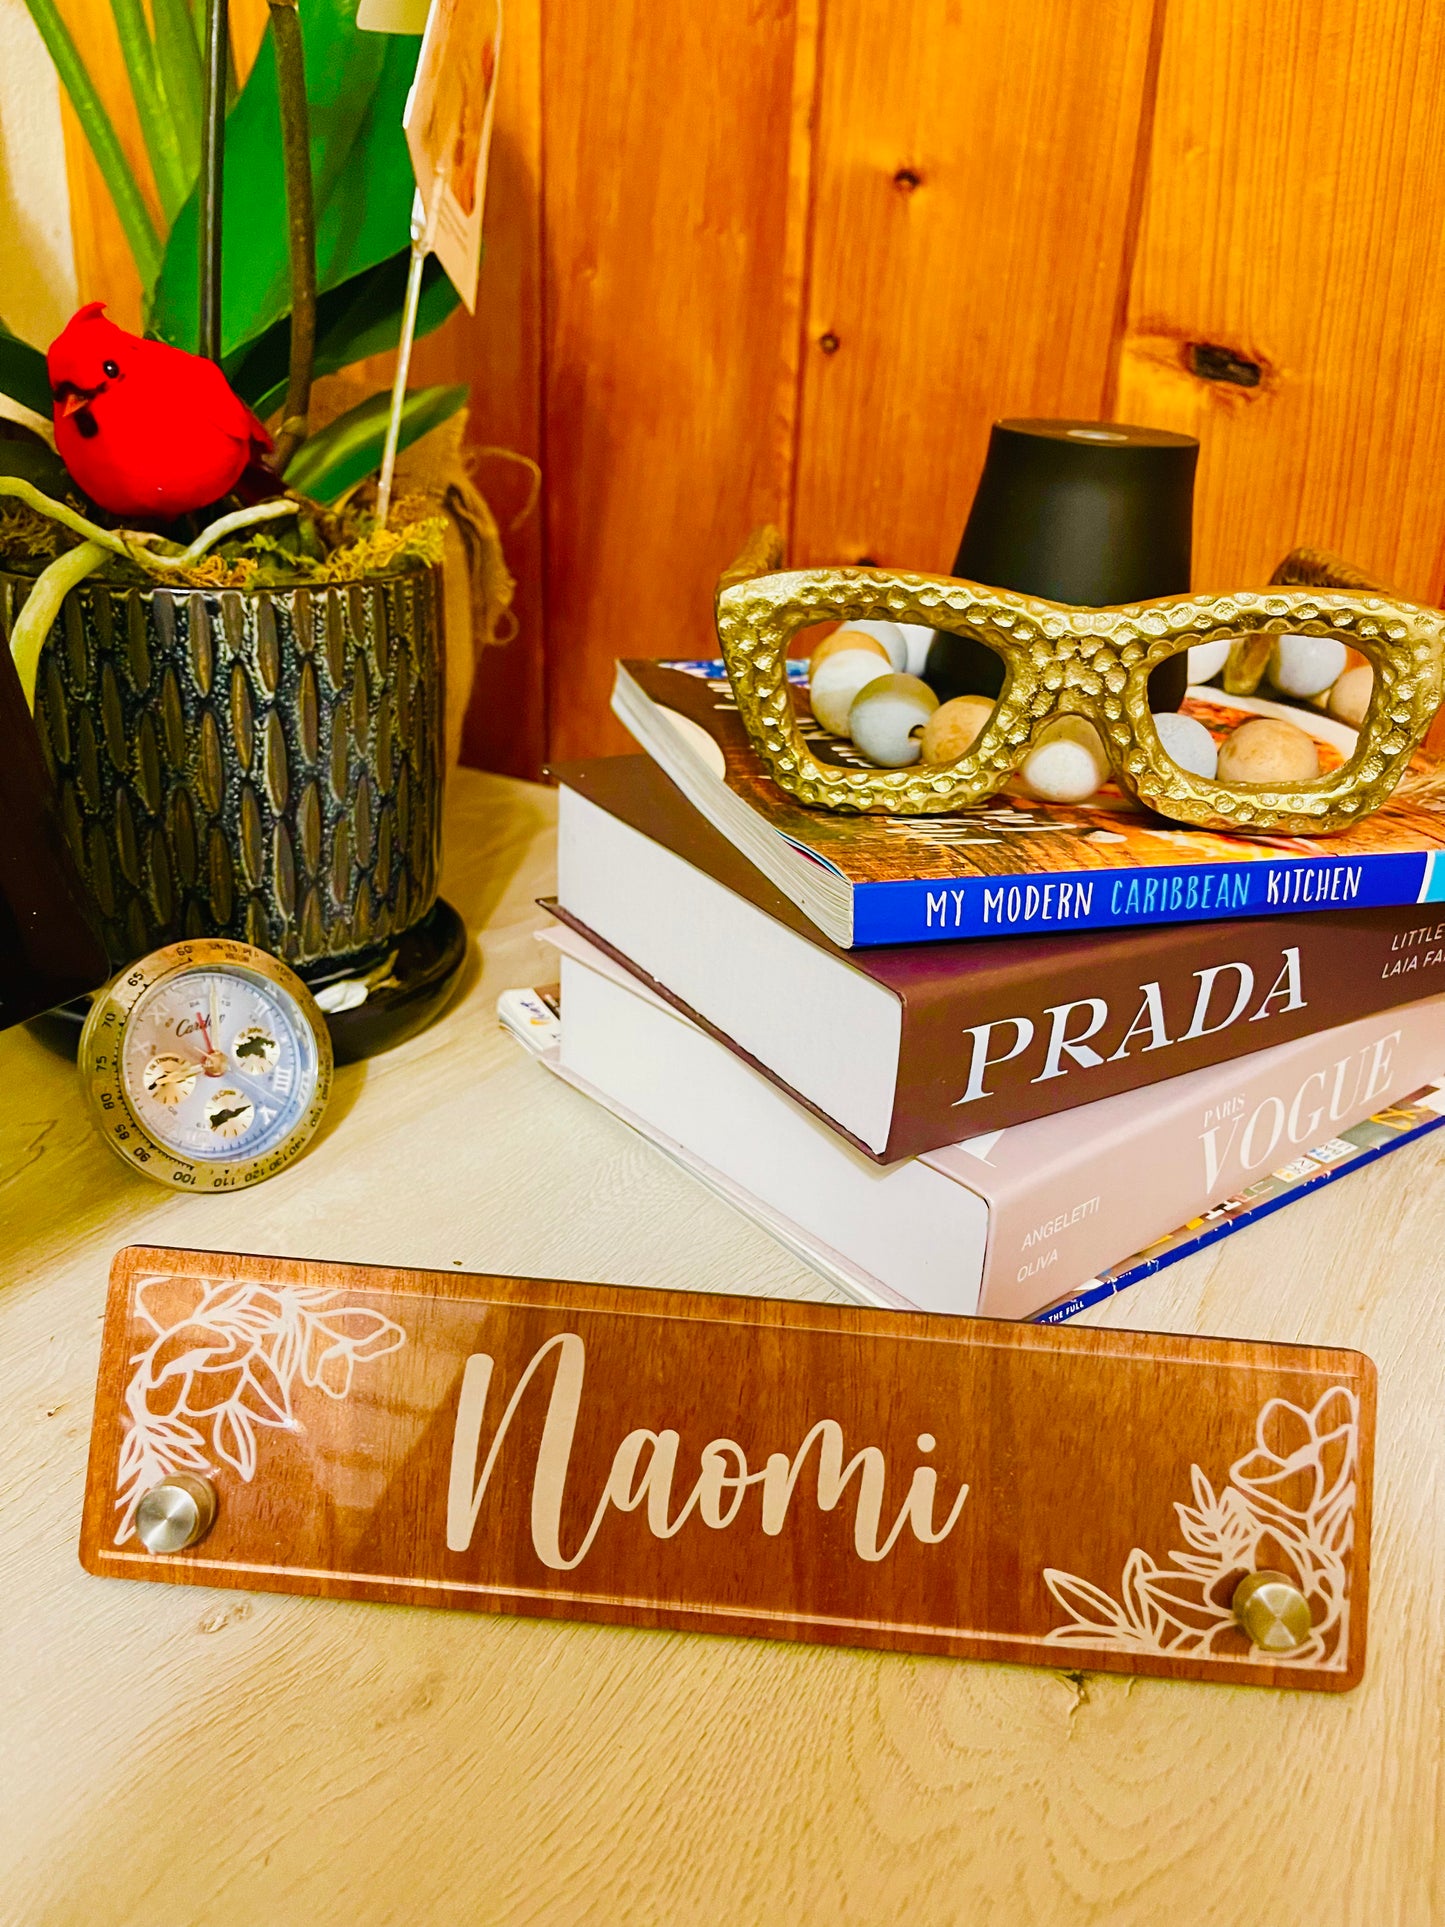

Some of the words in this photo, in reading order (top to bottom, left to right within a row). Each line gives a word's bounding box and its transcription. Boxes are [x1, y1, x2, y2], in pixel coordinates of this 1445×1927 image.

[926, 889, 965, 928] MY
[982, 881, 1095, 924] MODERN
[1110, 872, 1251, 915] CARIBBEAN
[1266, 865, 1363, 902] KITCHEN
[1391, 922, 1445, 951] LITTLE
[1381, 955, 1418, 979] LAIA
[1423, 948, 1445, 968] FA
[127, 970, 145, 987] 65
[102, 1012, 117, 1029] 70
[951, 946, 1308, 1108] PRADA
[96, 1055, 107, 1073] 75
[100, 1092, 115, 1110] 80
[1202, 1092, 1246, 1127] PARIS
[1198, 1029, 1403, 1195] VOGUE
[114, 1123, 130, 1140] 85
[133, 1147, 151, 1162] 90
[269, 1153, 288, 1171] 130
[172, 1171, 197, 1185] 100
[213, 1177, 235, 1188] 110
[244, 1170, 265, 1182] 120
[1021, 1196, 1101, 1251] ANGELETTI
[1016, 1248, 1059, 1282] OLIVA
[1048, 1310, 1064, 1323] THE
[1065, 1300, 1085, 1316] FULL
[446, 1332, 970, 1571] Naomi
